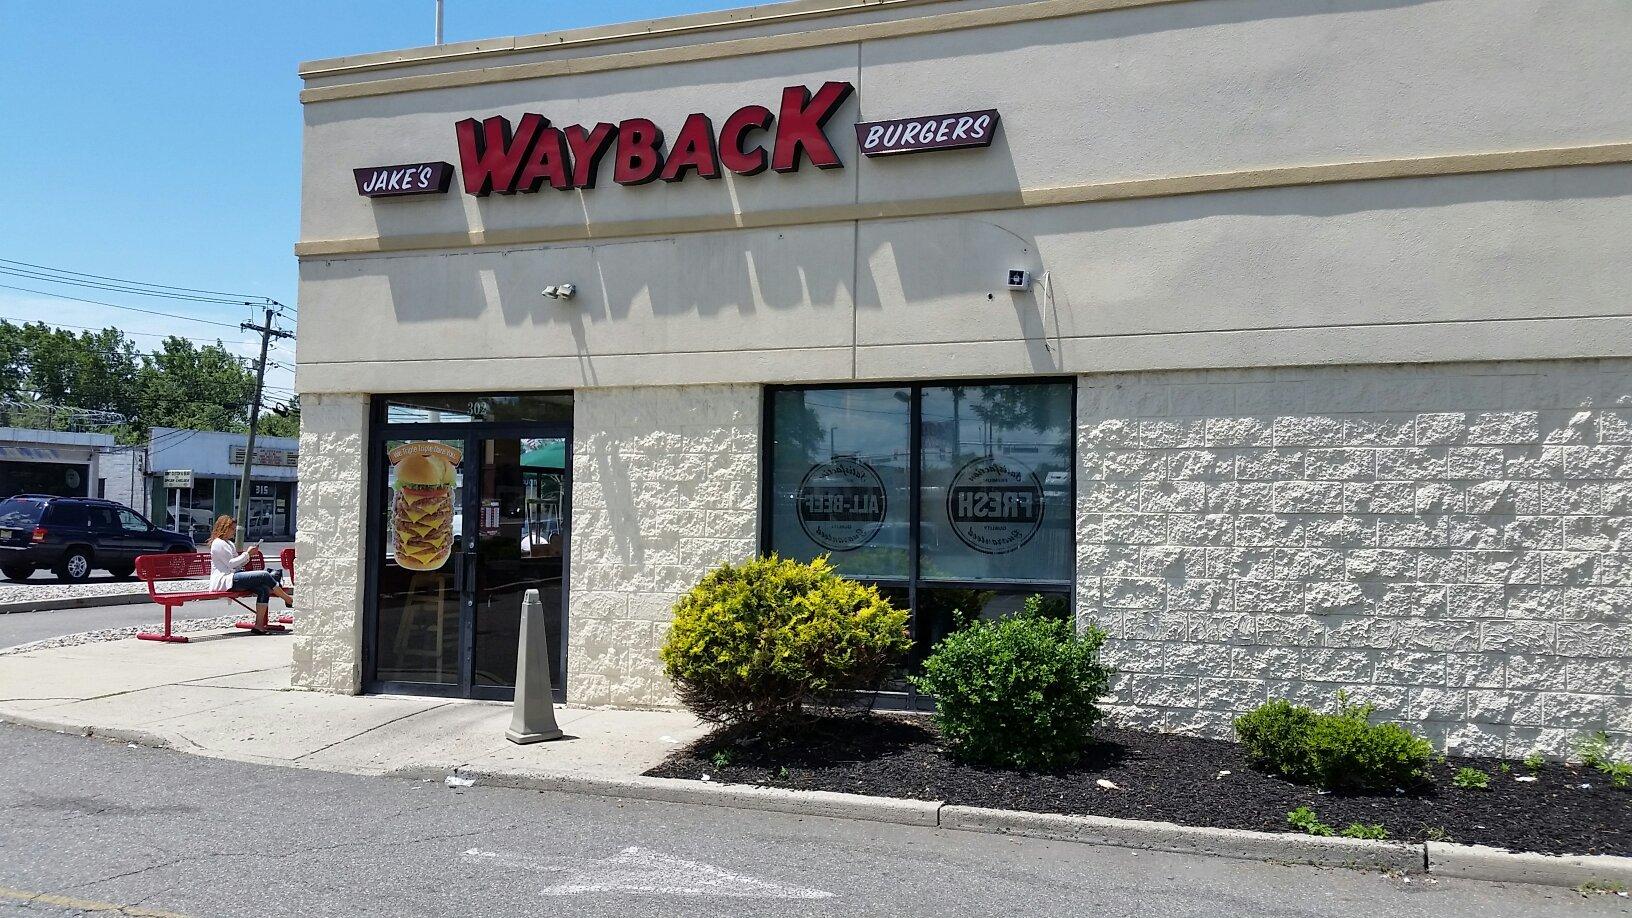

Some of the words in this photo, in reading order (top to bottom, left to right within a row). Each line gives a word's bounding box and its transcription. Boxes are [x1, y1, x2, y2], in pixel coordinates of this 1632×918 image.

[455, 81, 854, 195] WAYBACK
[864, 114, 991, 149] BURGERS
[363, 165, 433, 192] JAKE'S
[466, 402, 488, 416] 302
[255, 485, 268, 494] 315
